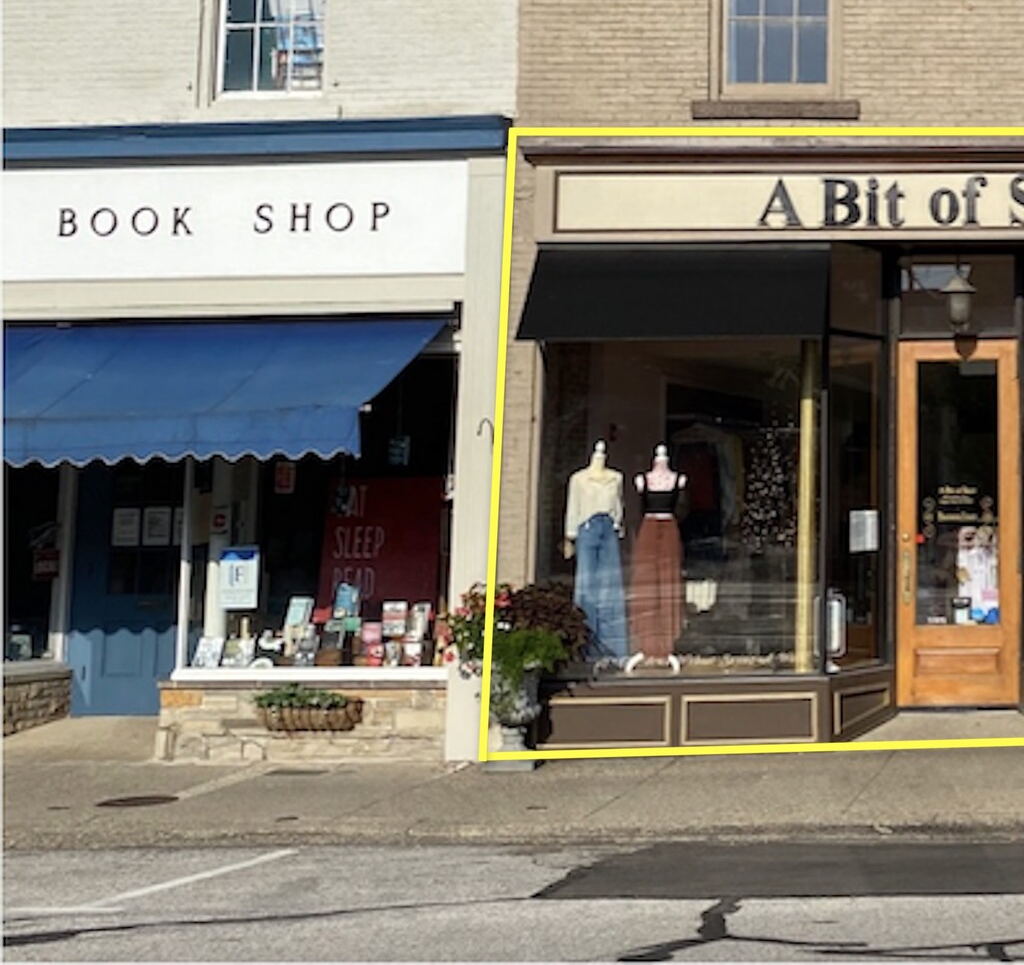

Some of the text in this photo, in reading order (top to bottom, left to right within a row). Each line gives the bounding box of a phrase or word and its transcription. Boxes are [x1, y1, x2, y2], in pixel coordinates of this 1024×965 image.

[757, 178, 803, 228] A
[821, 177, 905, 228] Bit
[928, 176, 987, 226] of
[57, 202, 390, 237] BOOK SHOP
[335, 484, 368, 517] AT
[332, 525, 385, 559] SLEEP
